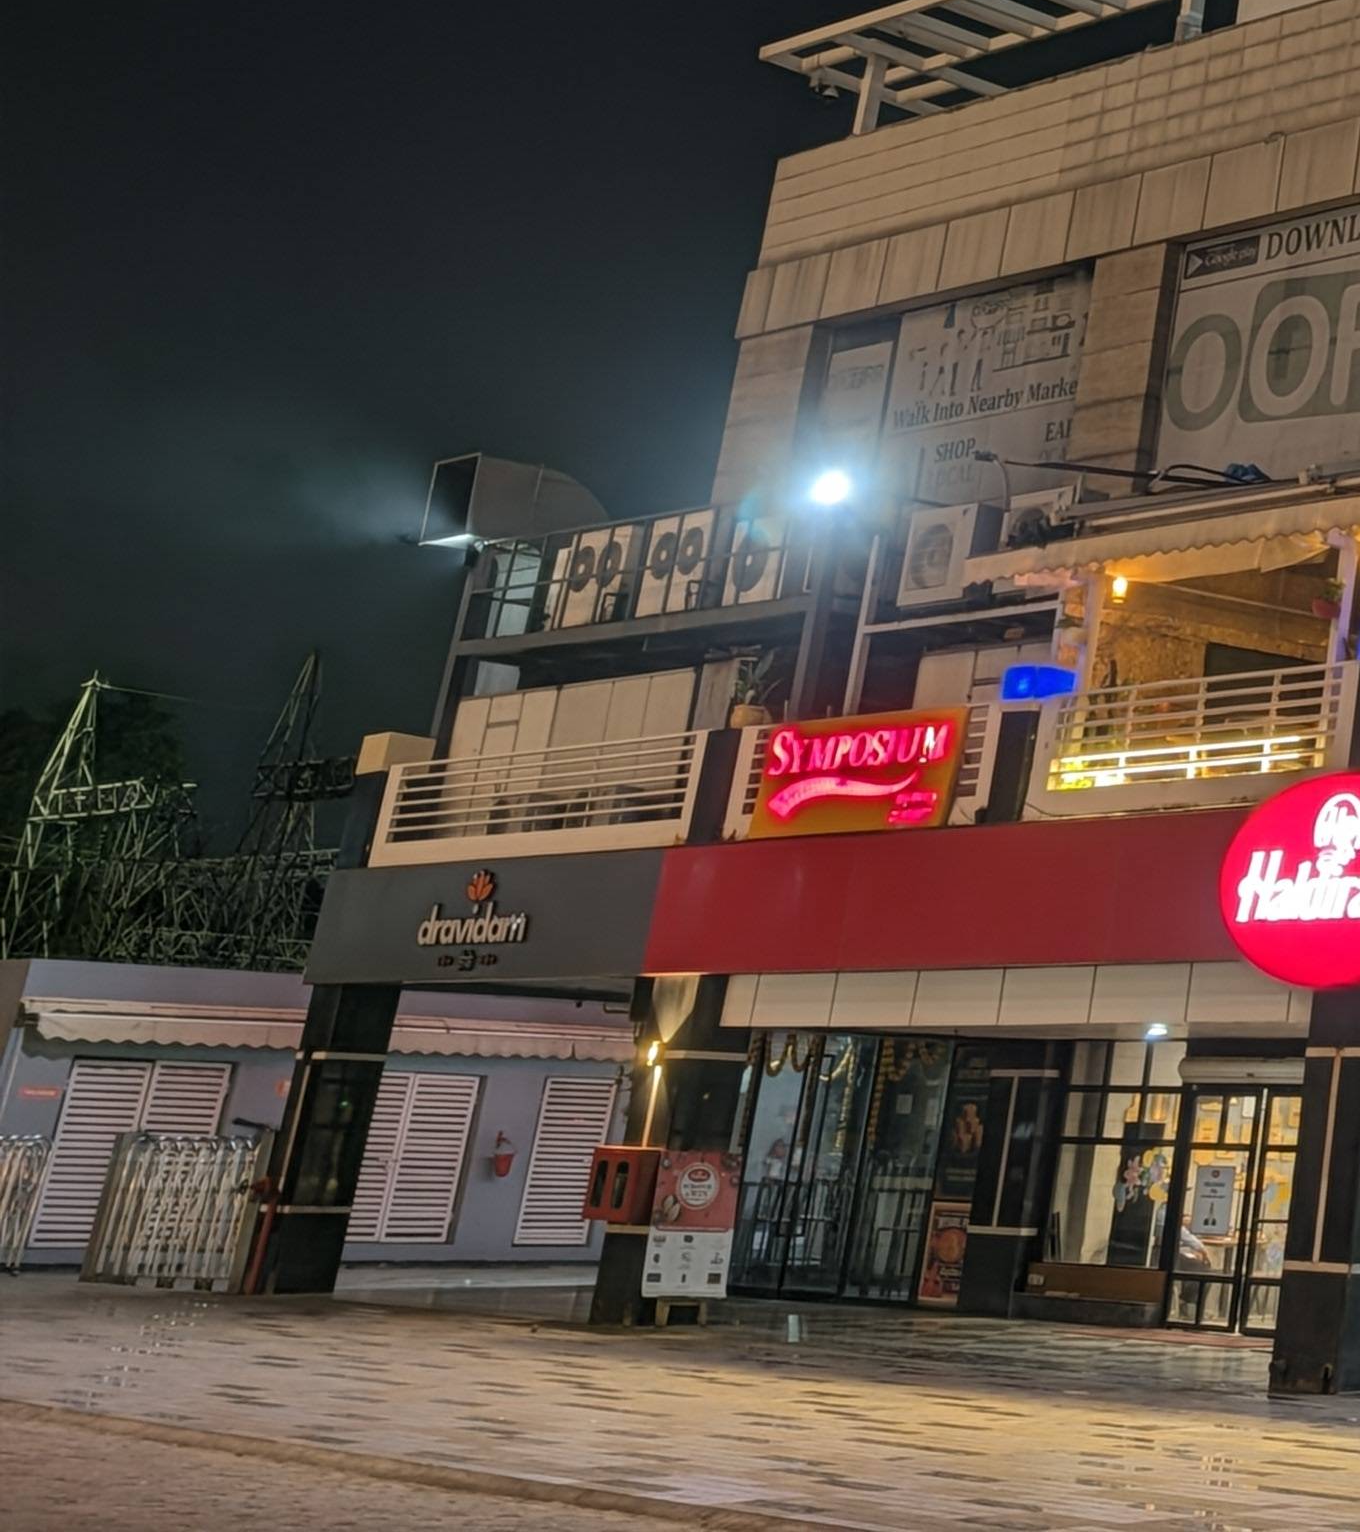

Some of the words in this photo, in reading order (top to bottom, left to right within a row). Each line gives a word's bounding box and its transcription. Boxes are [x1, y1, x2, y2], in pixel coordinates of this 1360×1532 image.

[933, 400, 964, 422] Into
[967, 386, 1024, 416] Nearby
[934, 437, 977, 464] SHOP
[767, 724, 949, 776] SYMPOSIUM
